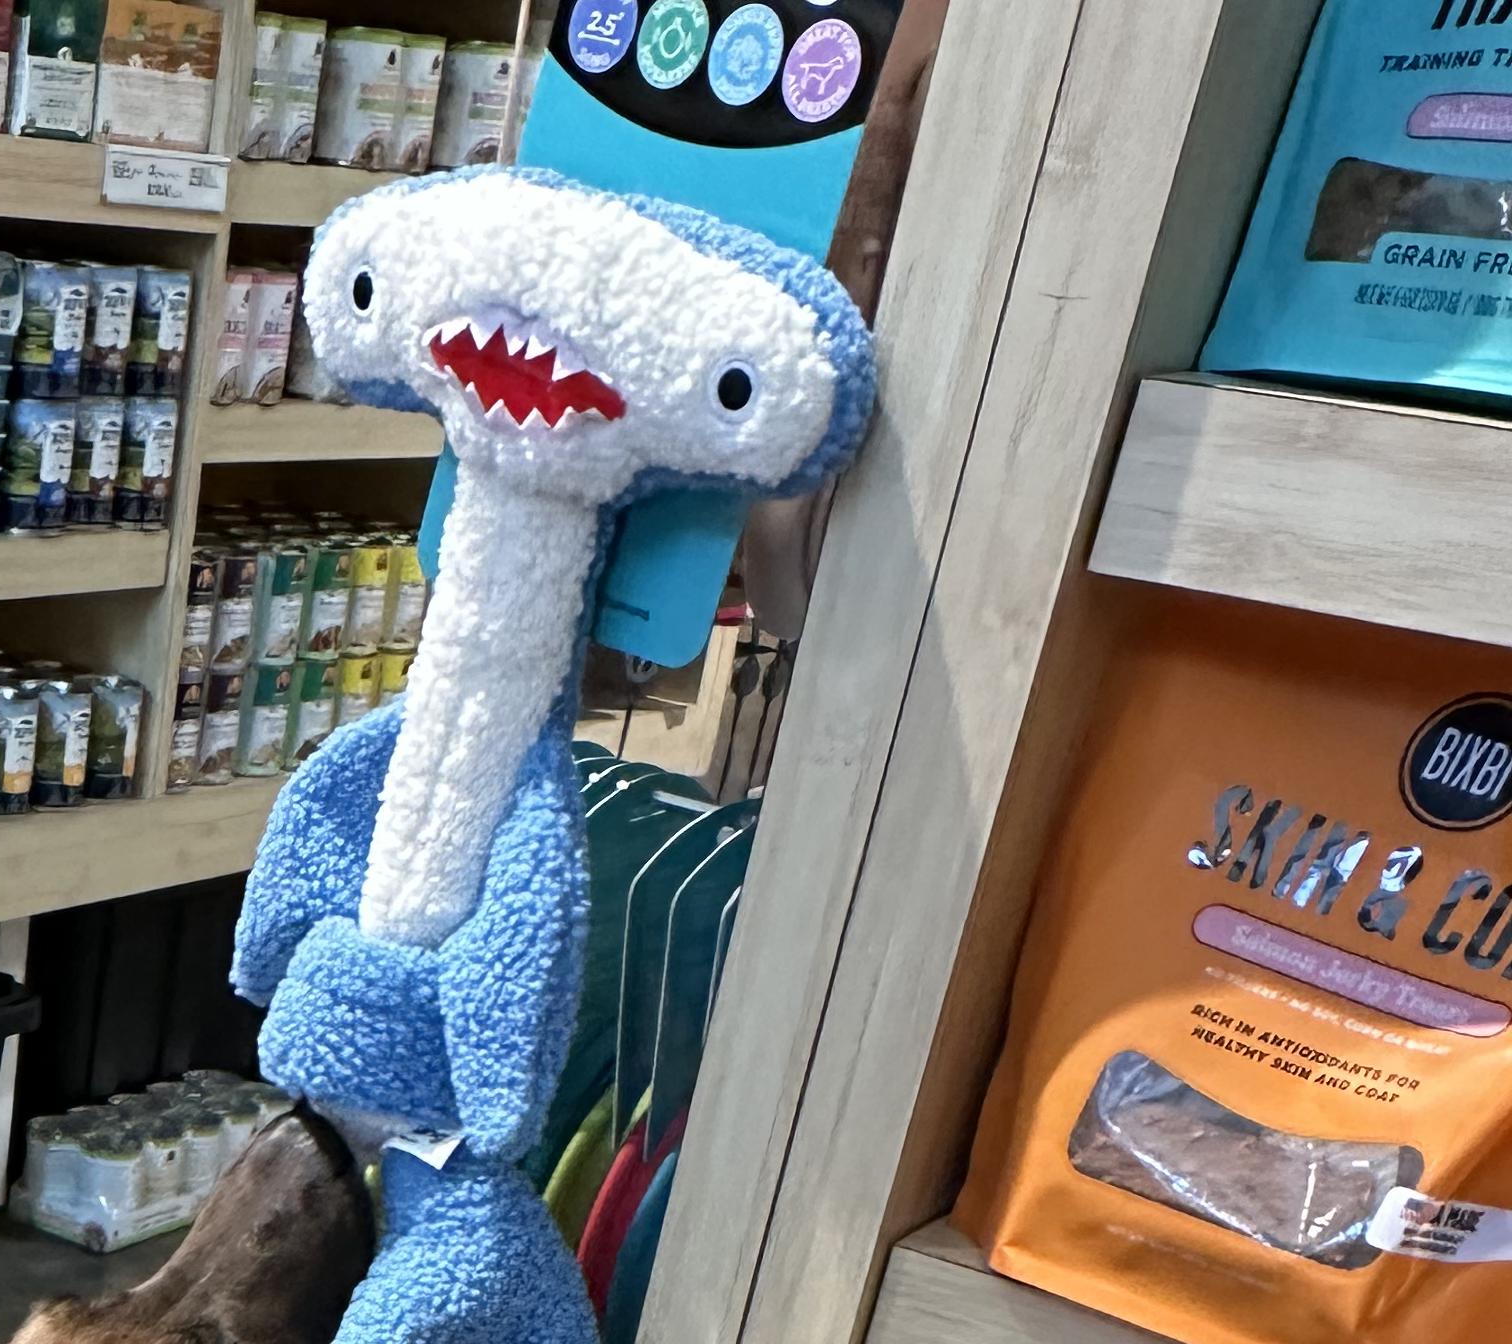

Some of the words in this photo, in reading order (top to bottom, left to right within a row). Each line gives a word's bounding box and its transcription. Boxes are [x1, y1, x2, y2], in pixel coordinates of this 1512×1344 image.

[1379, 48, 1485, 73] TRAINING
[1384, 243, 1466, 270] GRAIN
[1473, 251, 1512, 275] FR
[1420, 727, 1512, 801] BIXBI
[1188, 785, 1370, 915] SKIN
[1357, 846, 1424, 942] &
[1423, 868, 1512, 982] CO
[1191, 1004, 1234, 1028] RICH
[1235, 1020, 1256, 1036] IN
[1385, 1073, 1420, 1090] FOR
[1191, 1026, 1269, 1062] HEALTHY
[1270, 1057, 1311, 1080] SKIN
[1314, 1073, 1350, 1091] AND
[1354, 1084, 1400, 1103] COAT
